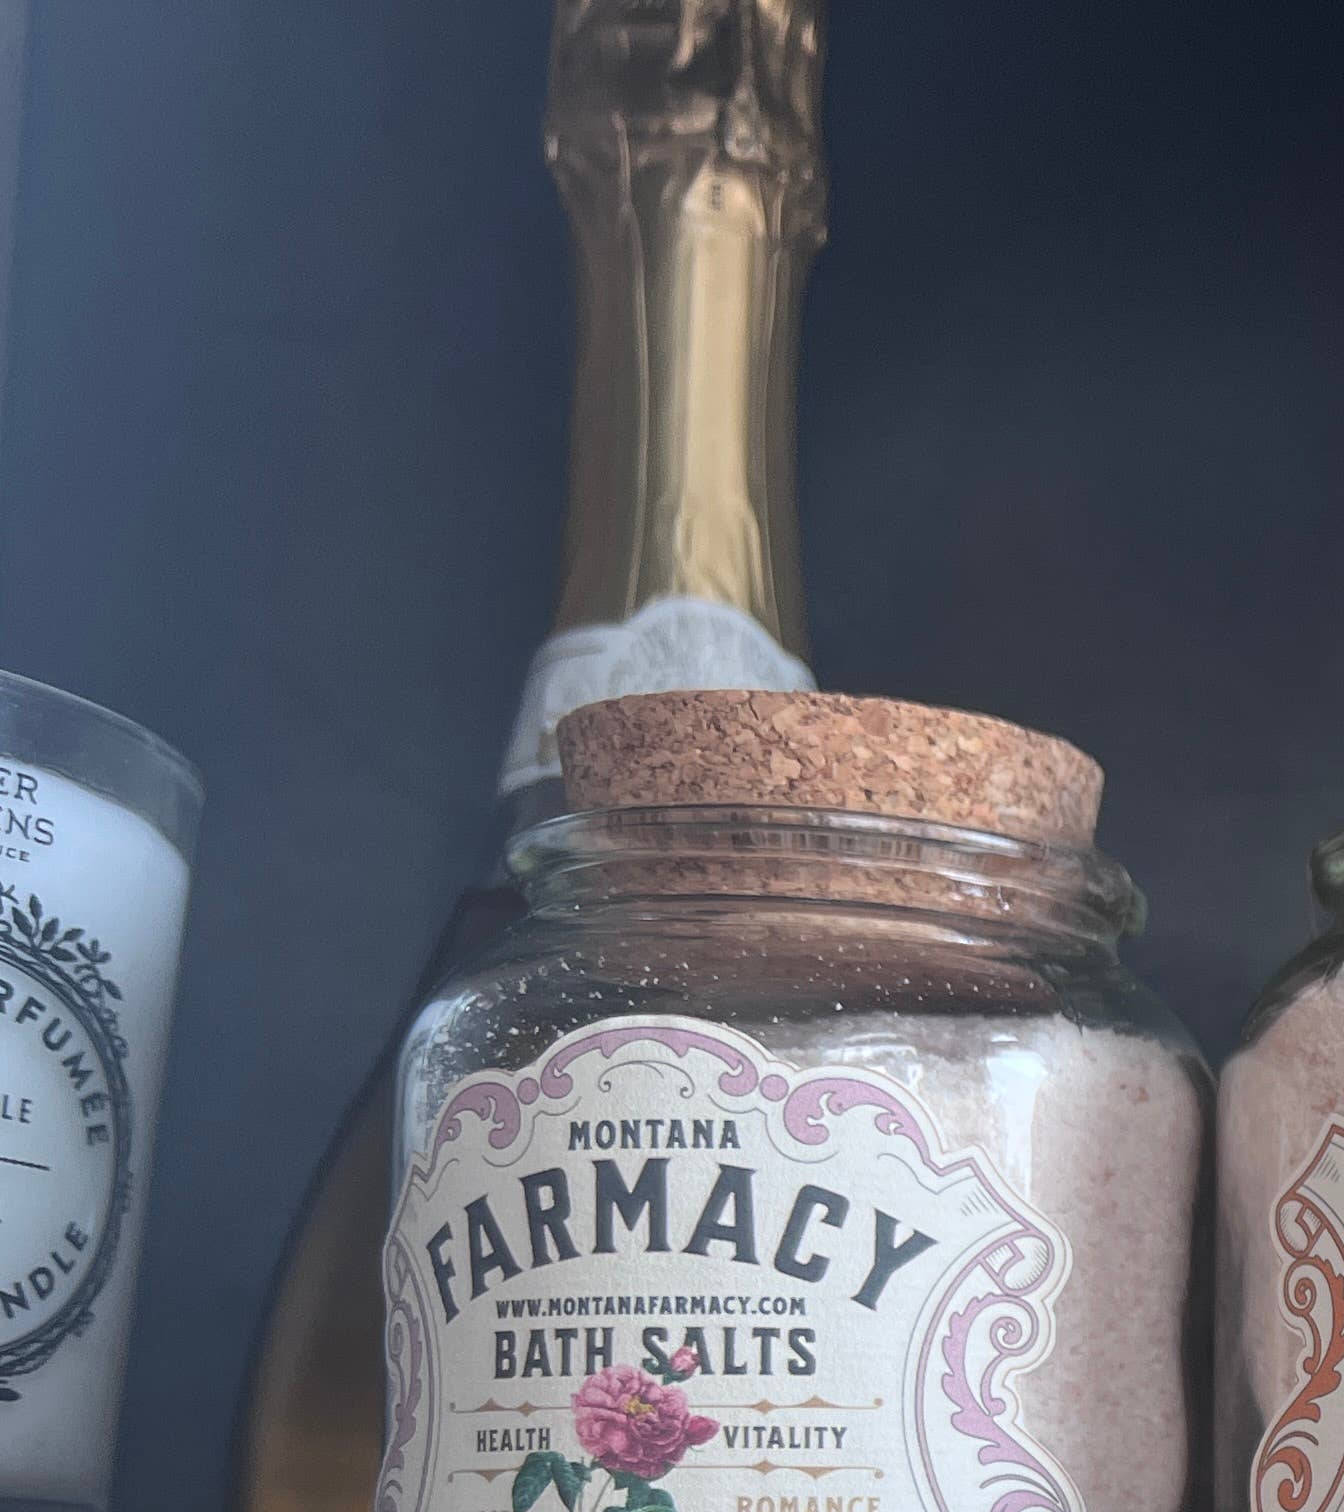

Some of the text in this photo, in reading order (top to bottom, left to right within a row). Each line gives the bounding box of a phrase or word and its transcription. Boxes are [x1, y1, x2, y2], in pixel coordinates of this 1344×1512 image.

[0, 806, 54, 845] NS
[568, 1119, 740, 1151] MONTANA
[426, 1157, 939, 1324] FARMACY
[496, 1296, 806, 1317] WWW.MONTANAFARMACY.COM
[494, 1327, 816, 1379] BATH SALTS
[476, 1426, 847, 1453] HEALTH VITALITY
